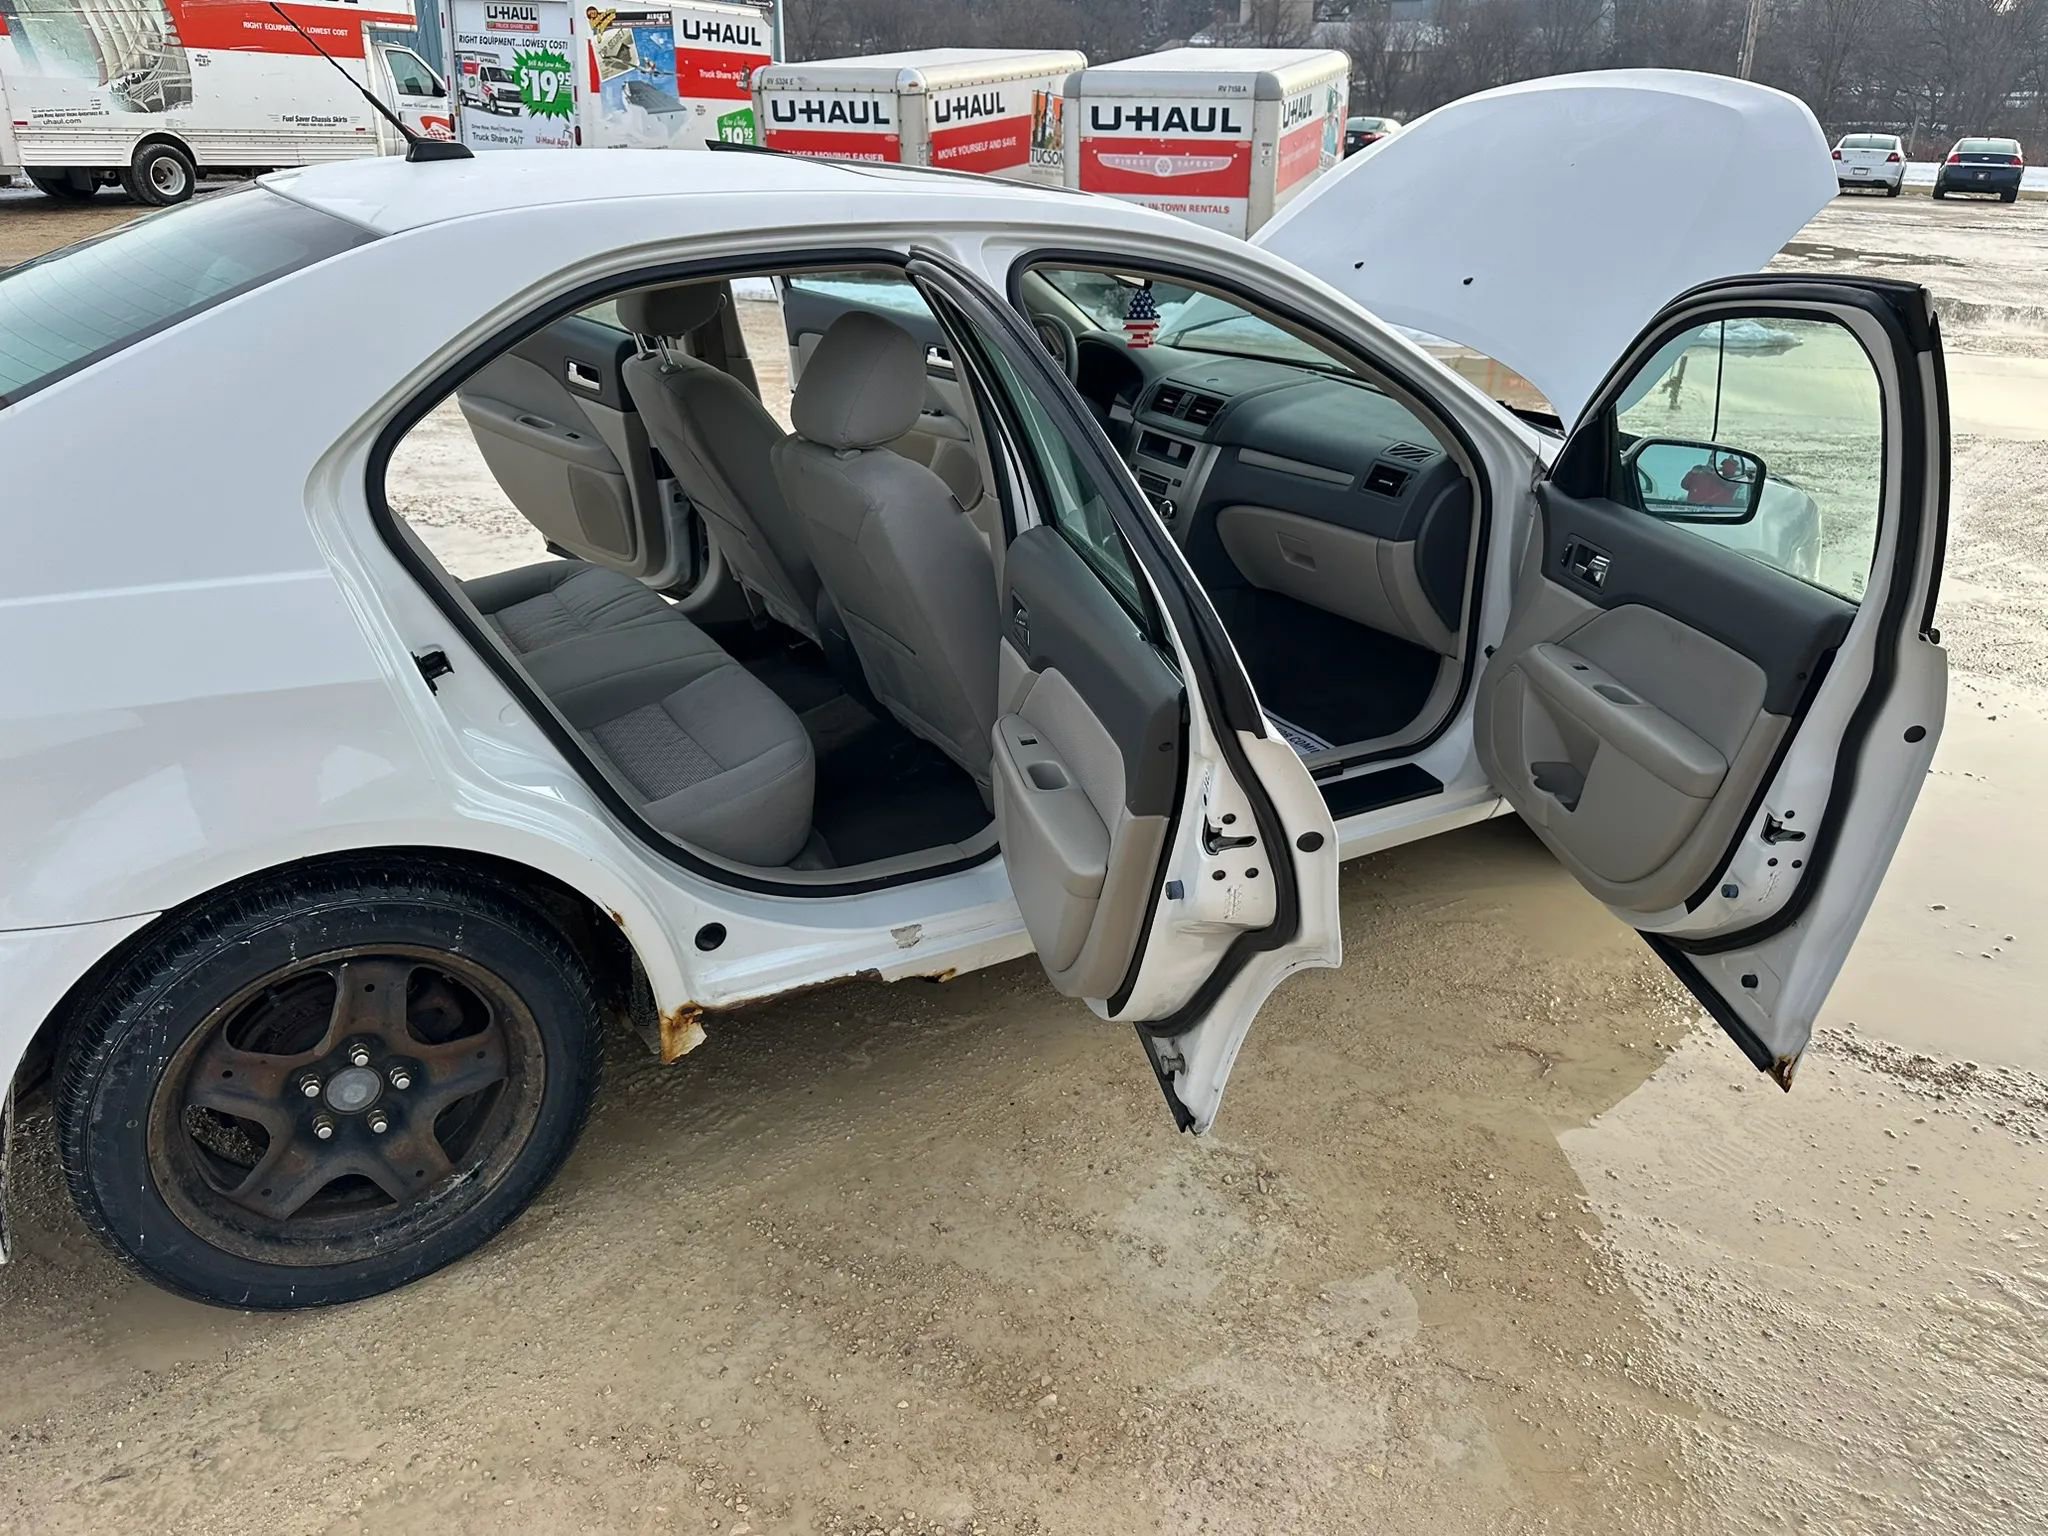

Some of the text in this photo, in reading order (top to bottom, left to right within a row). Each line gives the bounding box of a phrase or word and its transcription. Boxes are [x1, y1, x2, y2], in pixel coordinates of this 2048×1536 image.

[486, 6, 537, 21] U-HAUL
[243, 21, 263, 29] RIGHT
[306, 27, 332, 36] LOWEST
[332, 28, 348, 37] COST
[682, 19, 762, 47] U-HAUL
[459, 35, 478, 44] RIGHT
[522, 38, 547, 48] LOWEST
[549, 40, 568, 49] COST!
[699, 69, 745, 80] Truck Share 24/7
[771, 99, 890, 125] U-HAUL
[934, 91, 1005, 124] U-HAUL
[1282, 93, 1313, 128] U-HAUL
[43, 118, 81, 126] uhaul.com
[1091, 105, 1242, 133] U-HAUL
[472, 132, 524, 145] Truck Share 24/7
[536, 136, 569, 147] U-Haul App
[937, 147, 957, 160] MOVE
[958, 141, 989, 156] YOURSELF
[989, 138, 1001, 150] AND
[1002, 136, 1017, 148] SAVE
[852, 152, 884, 161] EASIER
[1115, 158, 1214, 168] FINEST SAFEST
[1188, 204, 1230, 214] RENTALS
